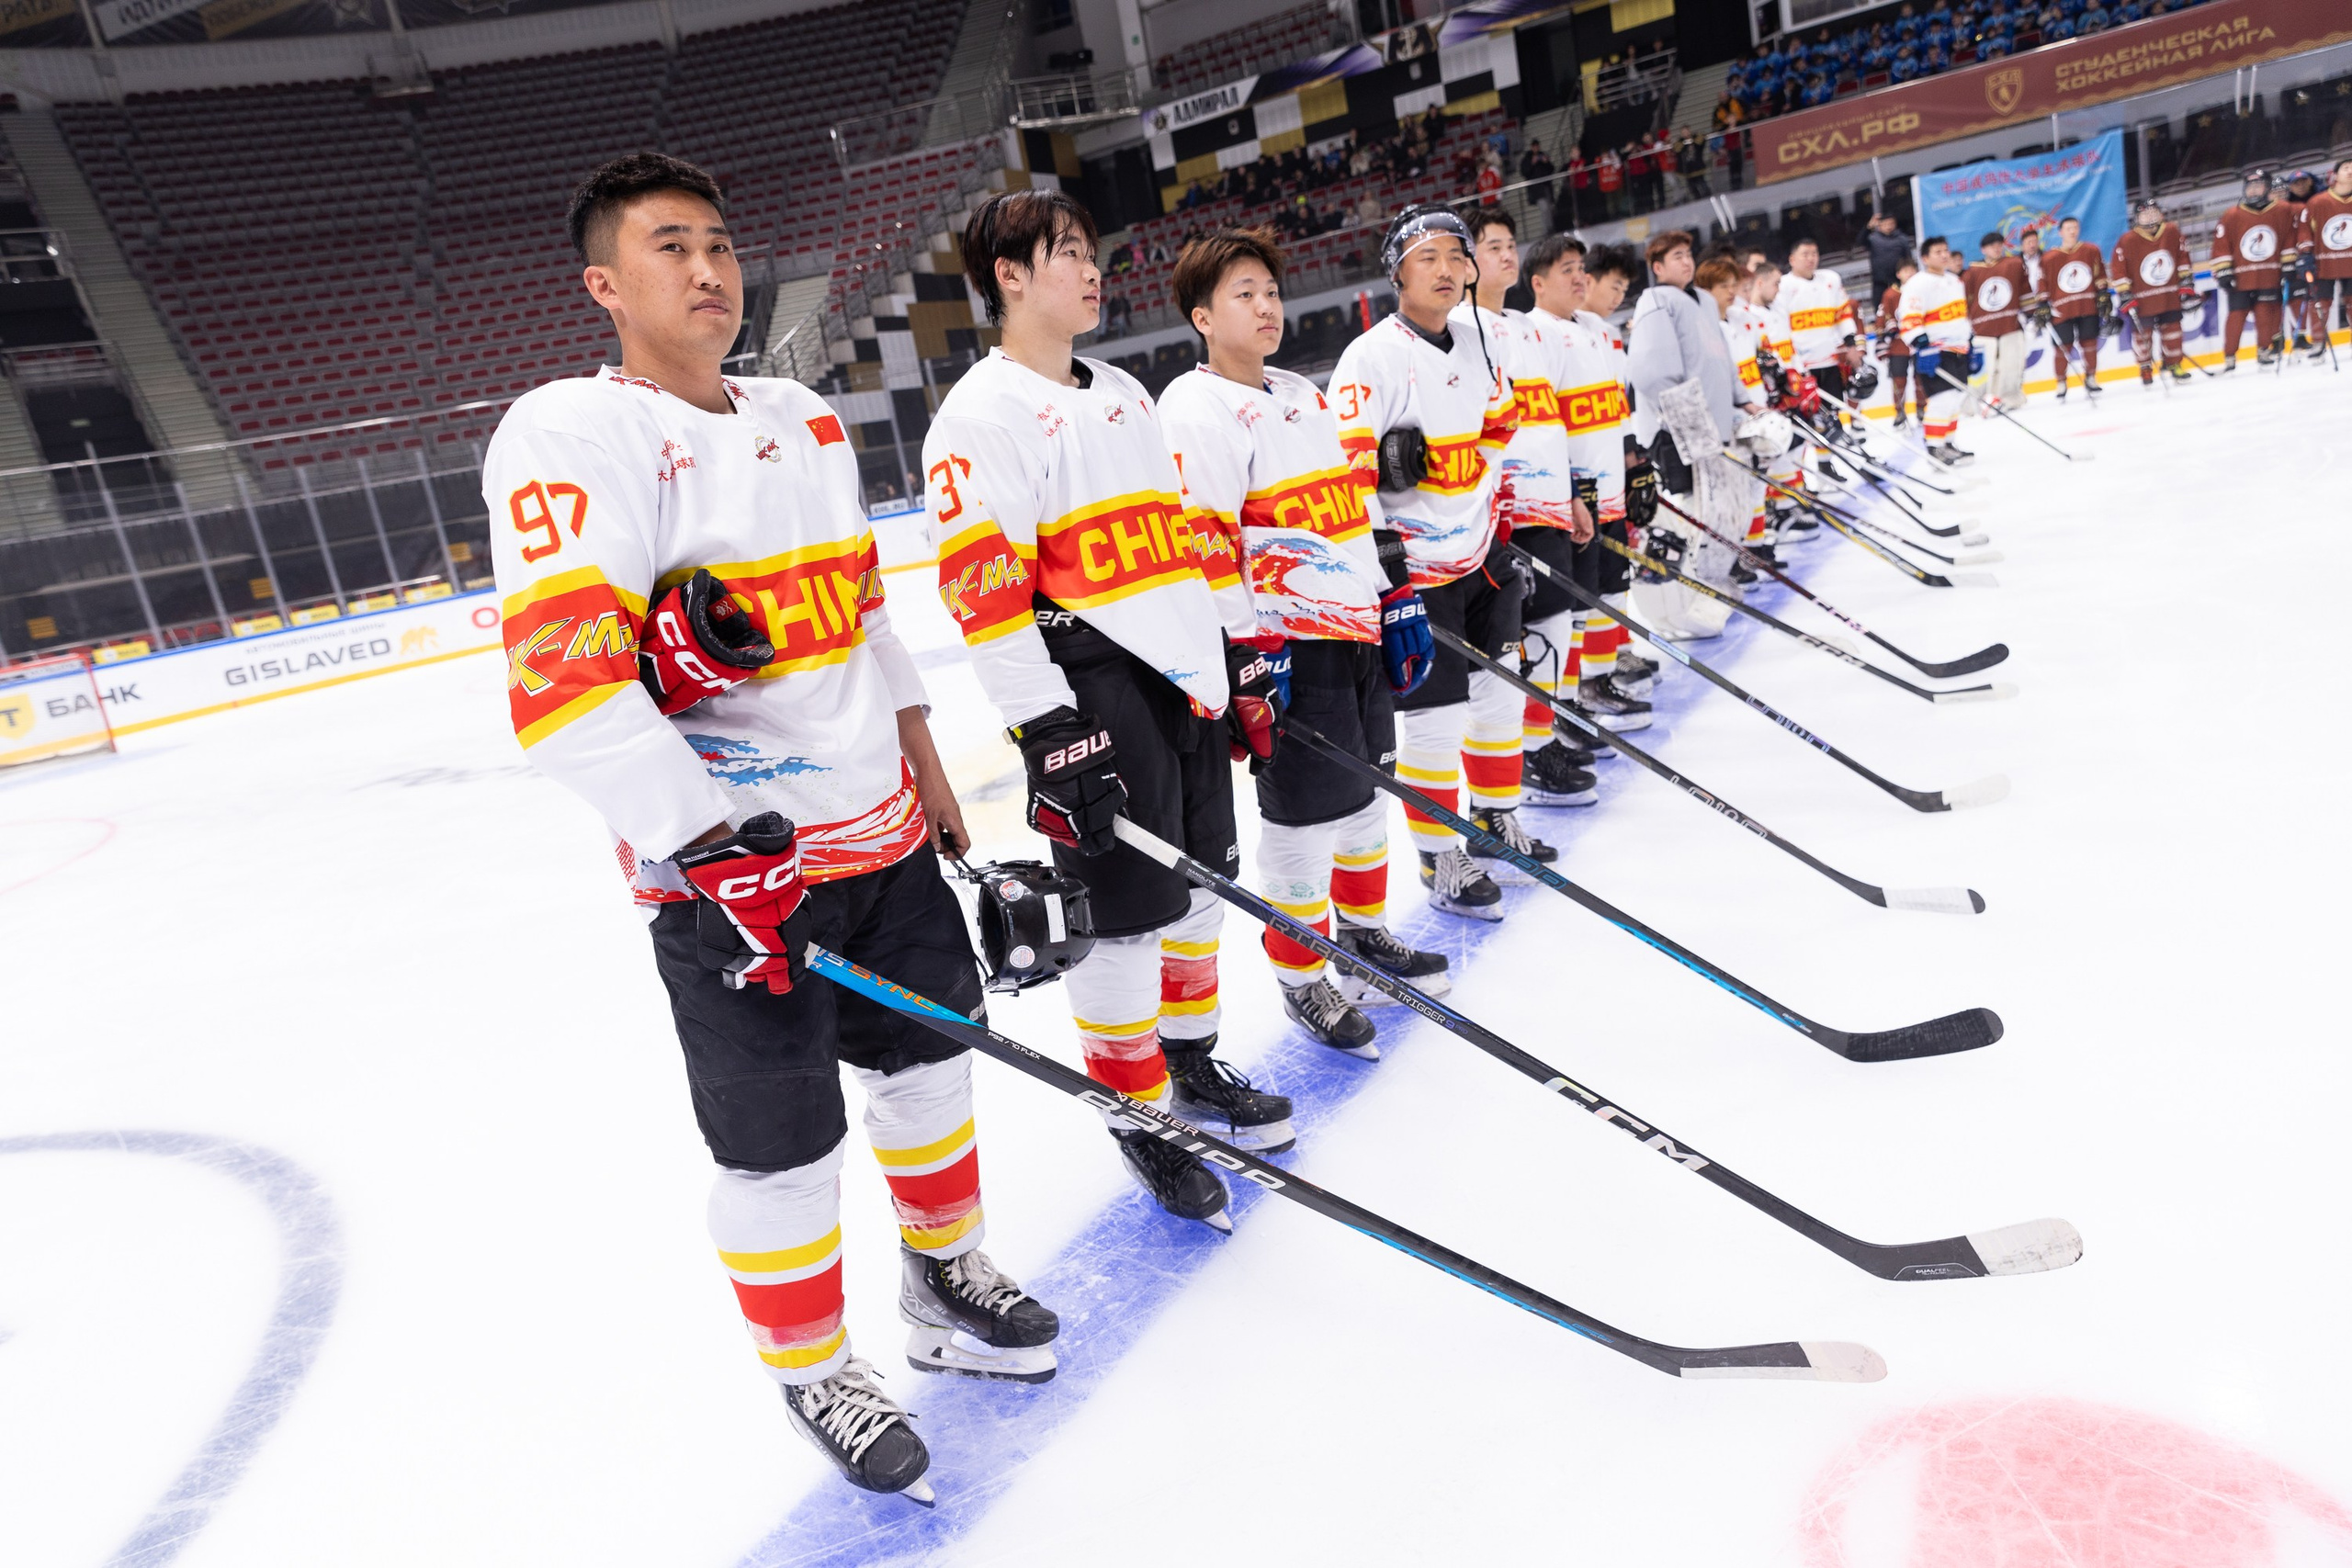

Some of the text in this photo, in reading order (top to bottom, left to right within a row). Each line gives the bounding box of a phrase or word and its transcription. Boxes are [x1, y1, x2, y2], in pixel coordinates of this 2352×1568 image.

[2055, 16, 2250, 79] СТУДЕНЧЕСКАЯ
[2056, 26, 2276, 93] ХОККЕЙНАЯ ЛИГА
[1174, 86, 1239, 123] АДМИРАЛ
[510, 479, 589, 565] 97
[225, 637, 391, 686] GISLAVED
[46, 683, 142, 719] БАНК
[848, 964, 939, 1012] SYNC
[1397, 990, 1447, 1024] TRIGGER
[1444, 1020, 1455, 1031] 9
[988, 1031, 1004, 1043] P92
[1020, 1047, 1041, 1060] FLEX
[1544, 1076, 1711, 1172] CCM
